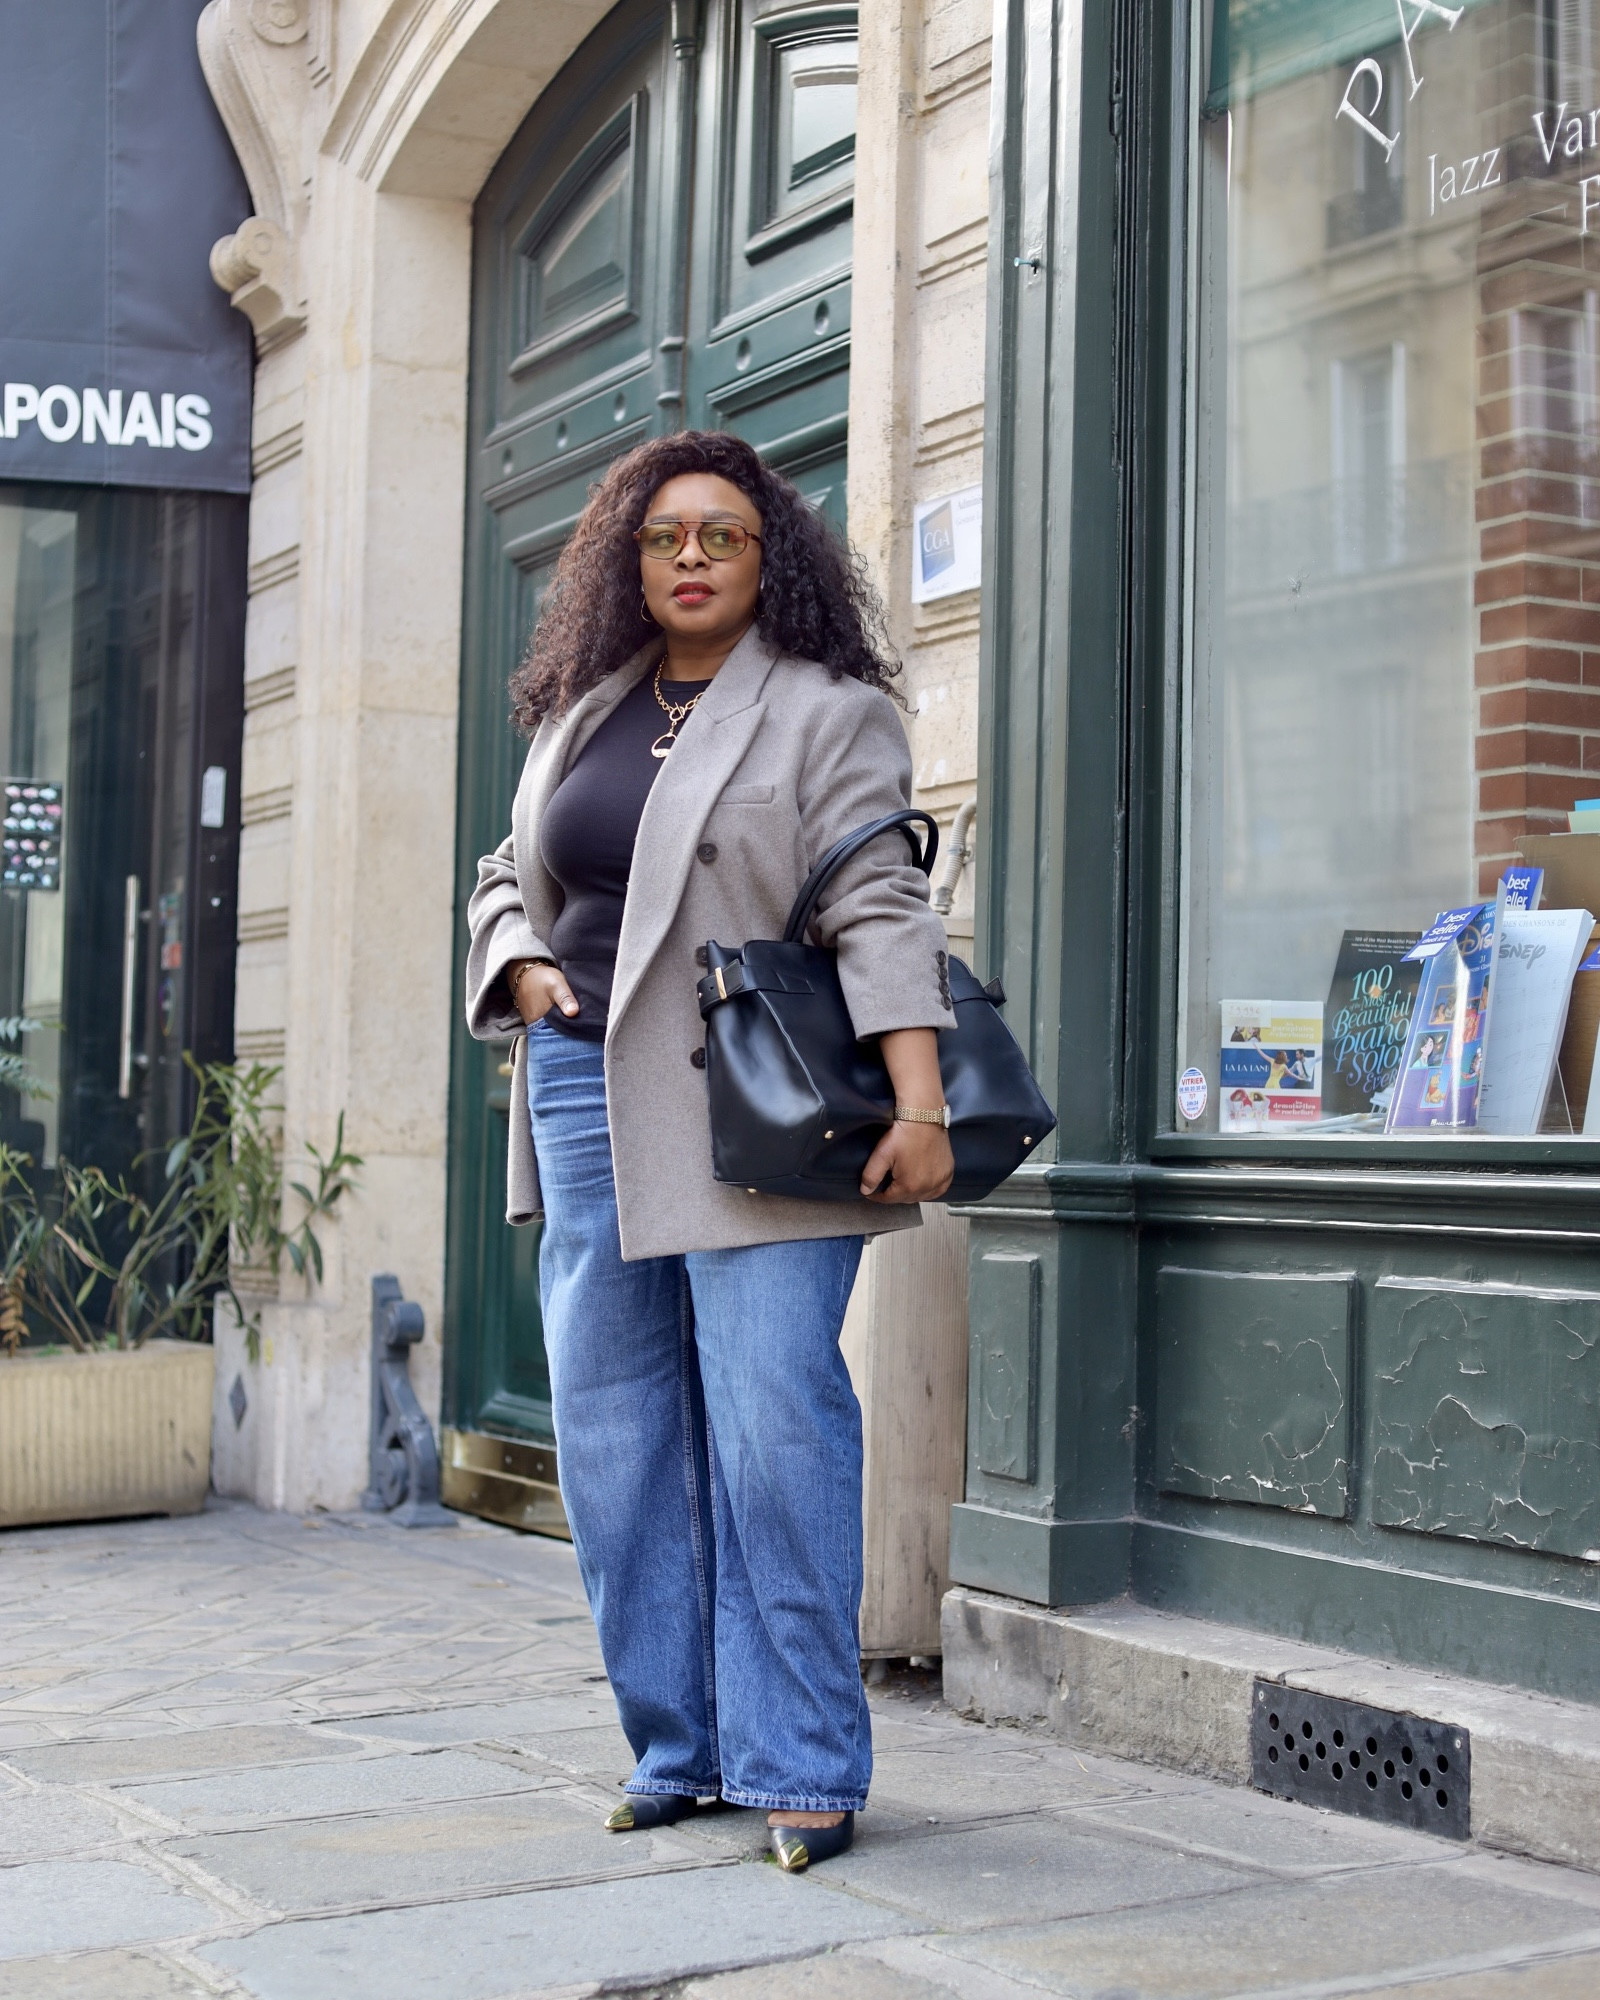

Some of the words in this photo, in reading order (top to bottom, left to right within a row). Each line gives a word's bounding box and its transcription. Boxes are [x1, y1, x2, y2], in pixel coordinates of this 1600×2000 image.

[1428, 148, 1501, 217] Jazz
[0, 382, 213, 451] PONAIS
[924, 528, 950, 553] CGA
[1507, 874, 1531, 890] best
[1506, 891, 1528, 907] eller
[1428, 923, 1464, 936] seller
[1443, 911, 1471, 924] best
[1350, 964, 1393, 1001] 100
[1332, 990, 1411, 1039] Beautiful
[1333, 1018, 1409, 1073] Piano
[1225, 1063, 1235, 1072] LA
[1237, 1063, 1248, 1072] LA
[1346, 1043, 1403, 1087] Solo
[1182, 1077, 1203, 1086] VITRIER
